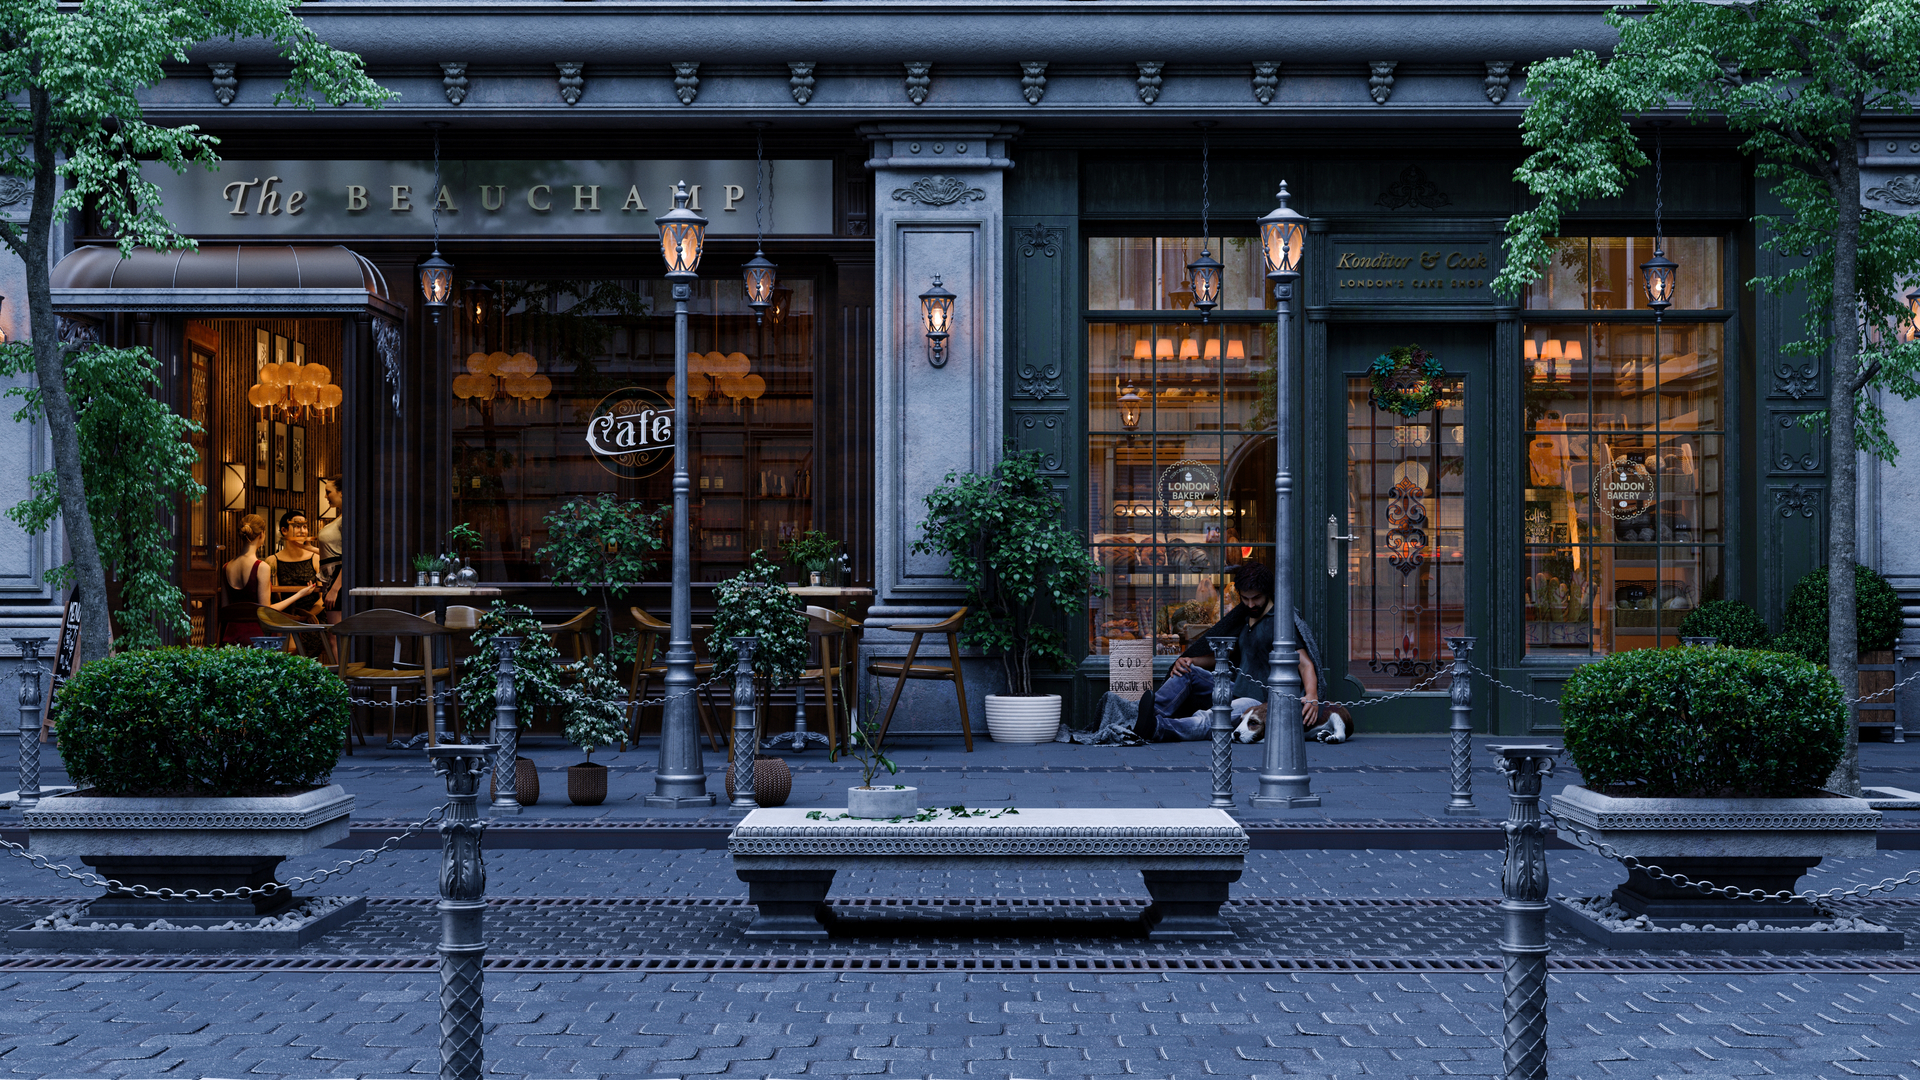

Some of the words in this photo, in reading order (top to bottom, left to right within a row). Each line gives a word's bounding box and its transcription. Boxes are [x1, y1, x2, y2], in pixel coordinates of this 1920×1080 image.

[223, 175, 306, 217] The
[346, 184, 746, 212] BEAUCHAMP
[1336, 252, 1413, 269] Konditor
[1420, 251, 1441, 269] &
[1446, 252, 1487, 269] Cook
[1340, 279, 1405, 289] LONDON'S
[1412, 279, 1443, 289] CAKE
[1451, 279, 1484, 289] SHOP
[585, 410, 674, 455] Cafe
[1168, 482, 1210, 491] LONDON
[1603, 482, 1645, 491] LONDON
[1172, 492, 1206, 500] BAKERY
[1607, 492, 1641, 500] BAKERY
[1142, 680, 1152, 691] US
